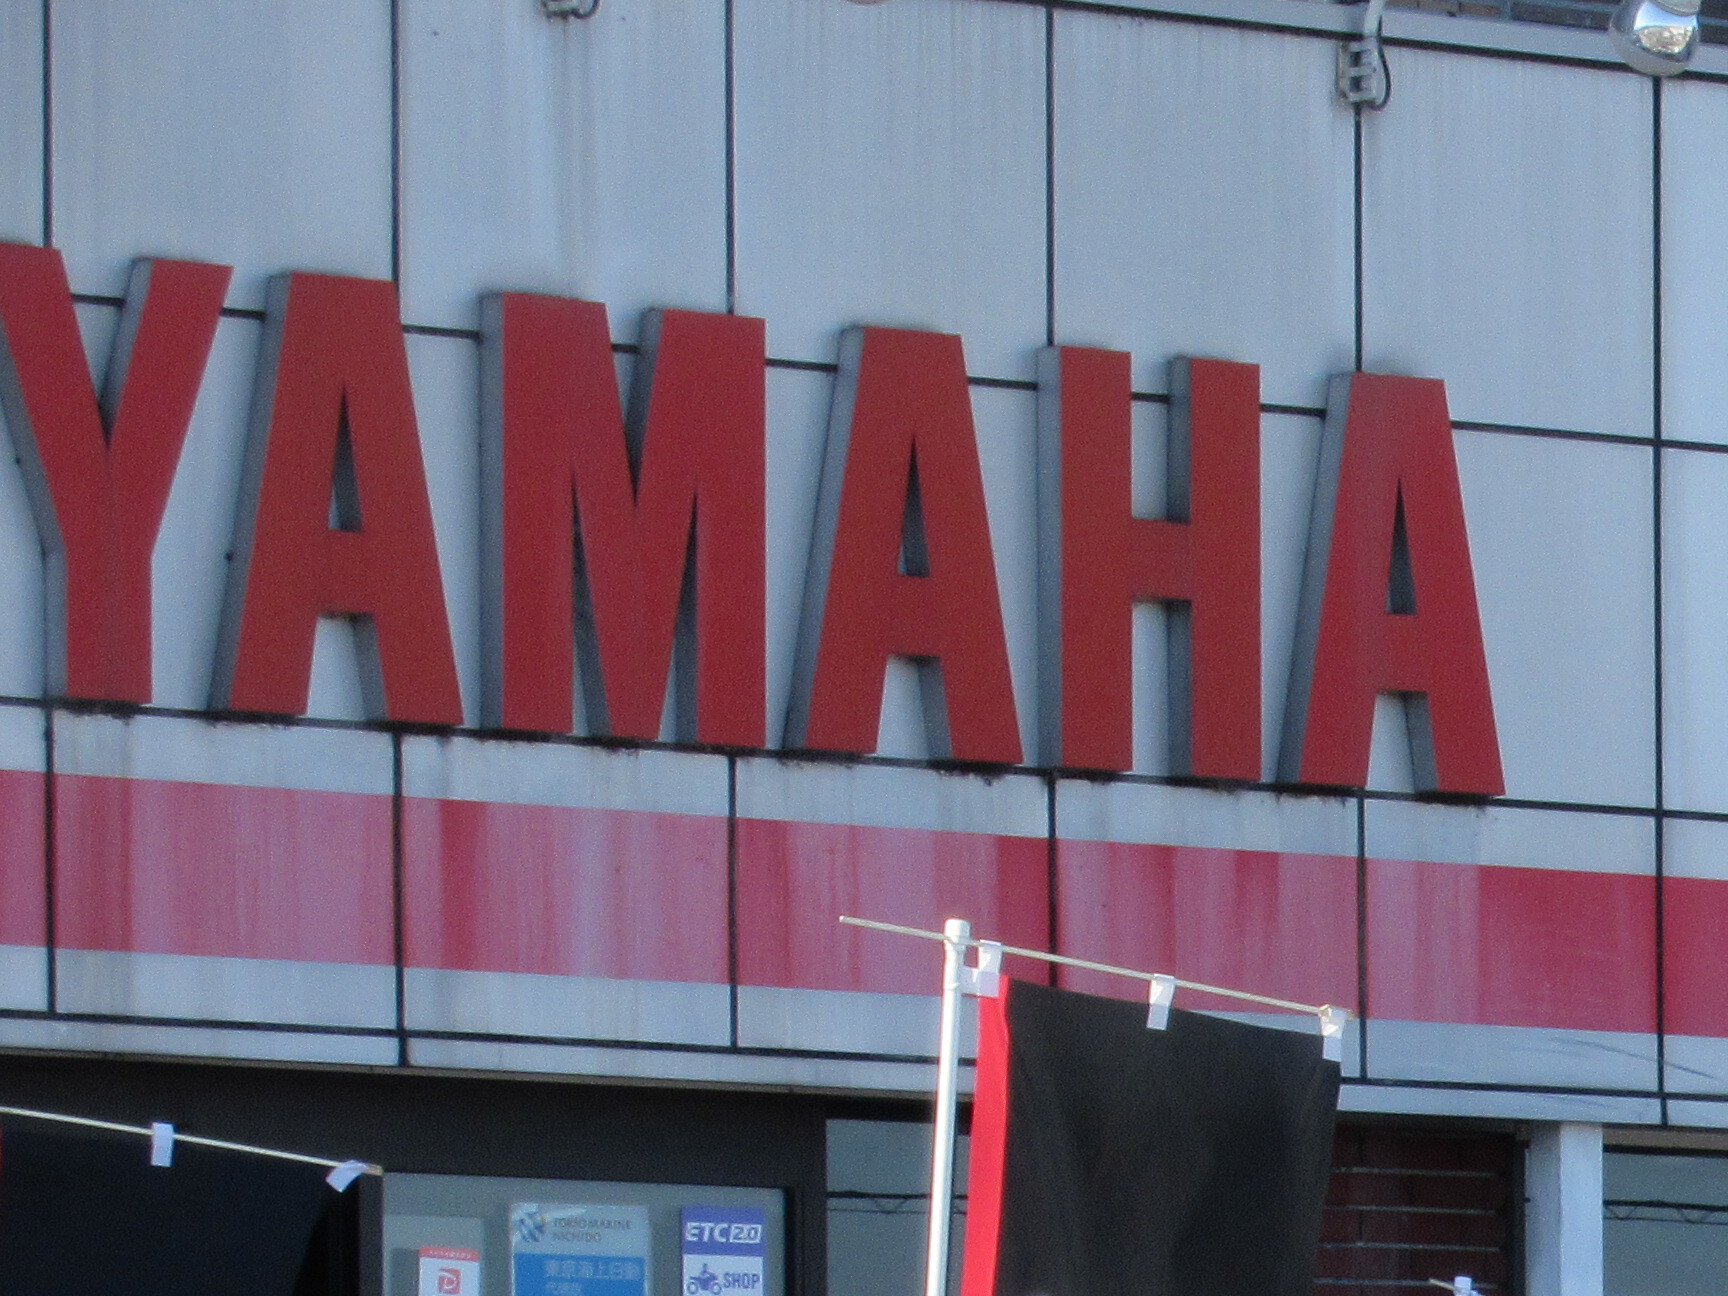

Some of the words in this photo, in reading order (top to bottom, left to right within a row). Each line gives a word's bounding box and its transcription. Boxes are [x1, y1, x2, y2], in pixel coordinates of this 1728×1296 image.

[0, 241, 1505, 798] YAMAHA
[686, 1222, 729, 1242] ETC
[723, 1272, 761, 1290] SHOP
